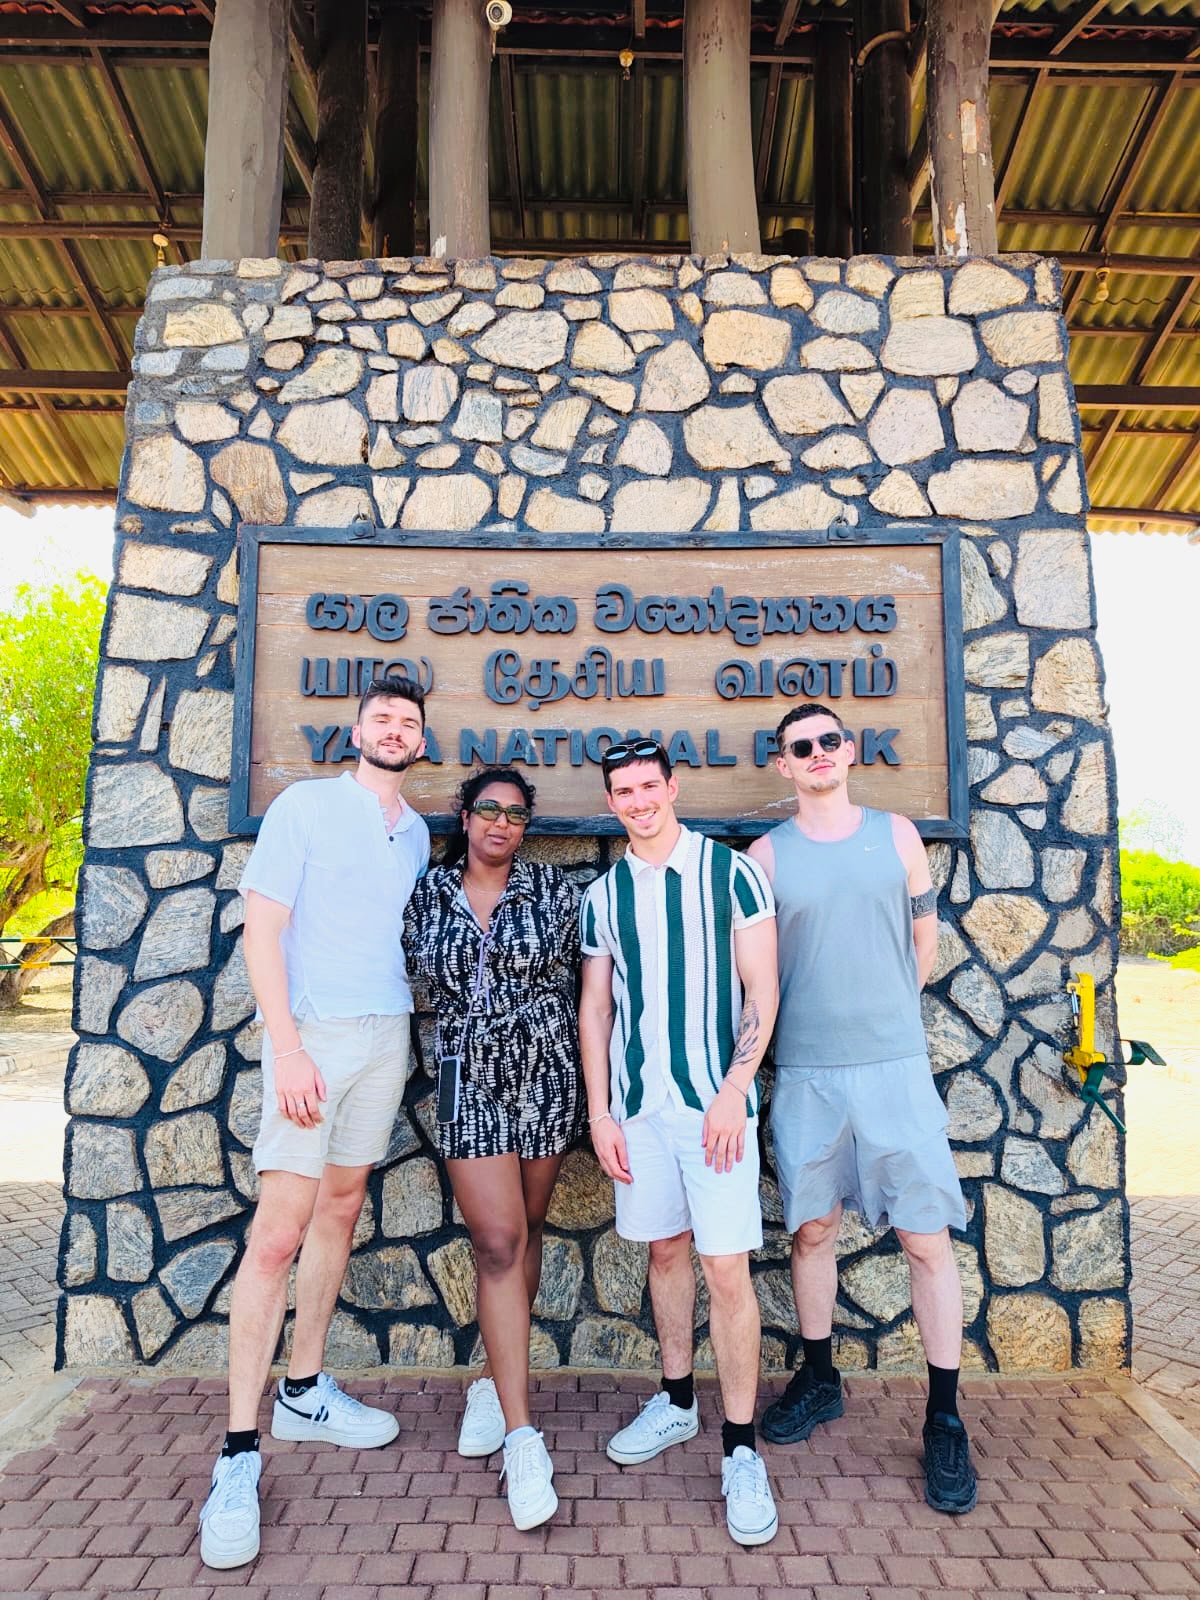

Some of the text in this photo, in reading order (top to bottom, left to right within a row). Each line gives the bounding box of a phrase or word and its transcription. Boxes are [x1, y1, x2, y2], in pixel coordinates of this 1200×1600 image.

[305, 591, 409, 642] යාල
[427, 580, 577, 635] ජාතික
[483, 645, 666, 711] தேசிய
[715, 643, 898, 700] வனம்
[302, 725, 901, 767] YAA NATIOAL PK
